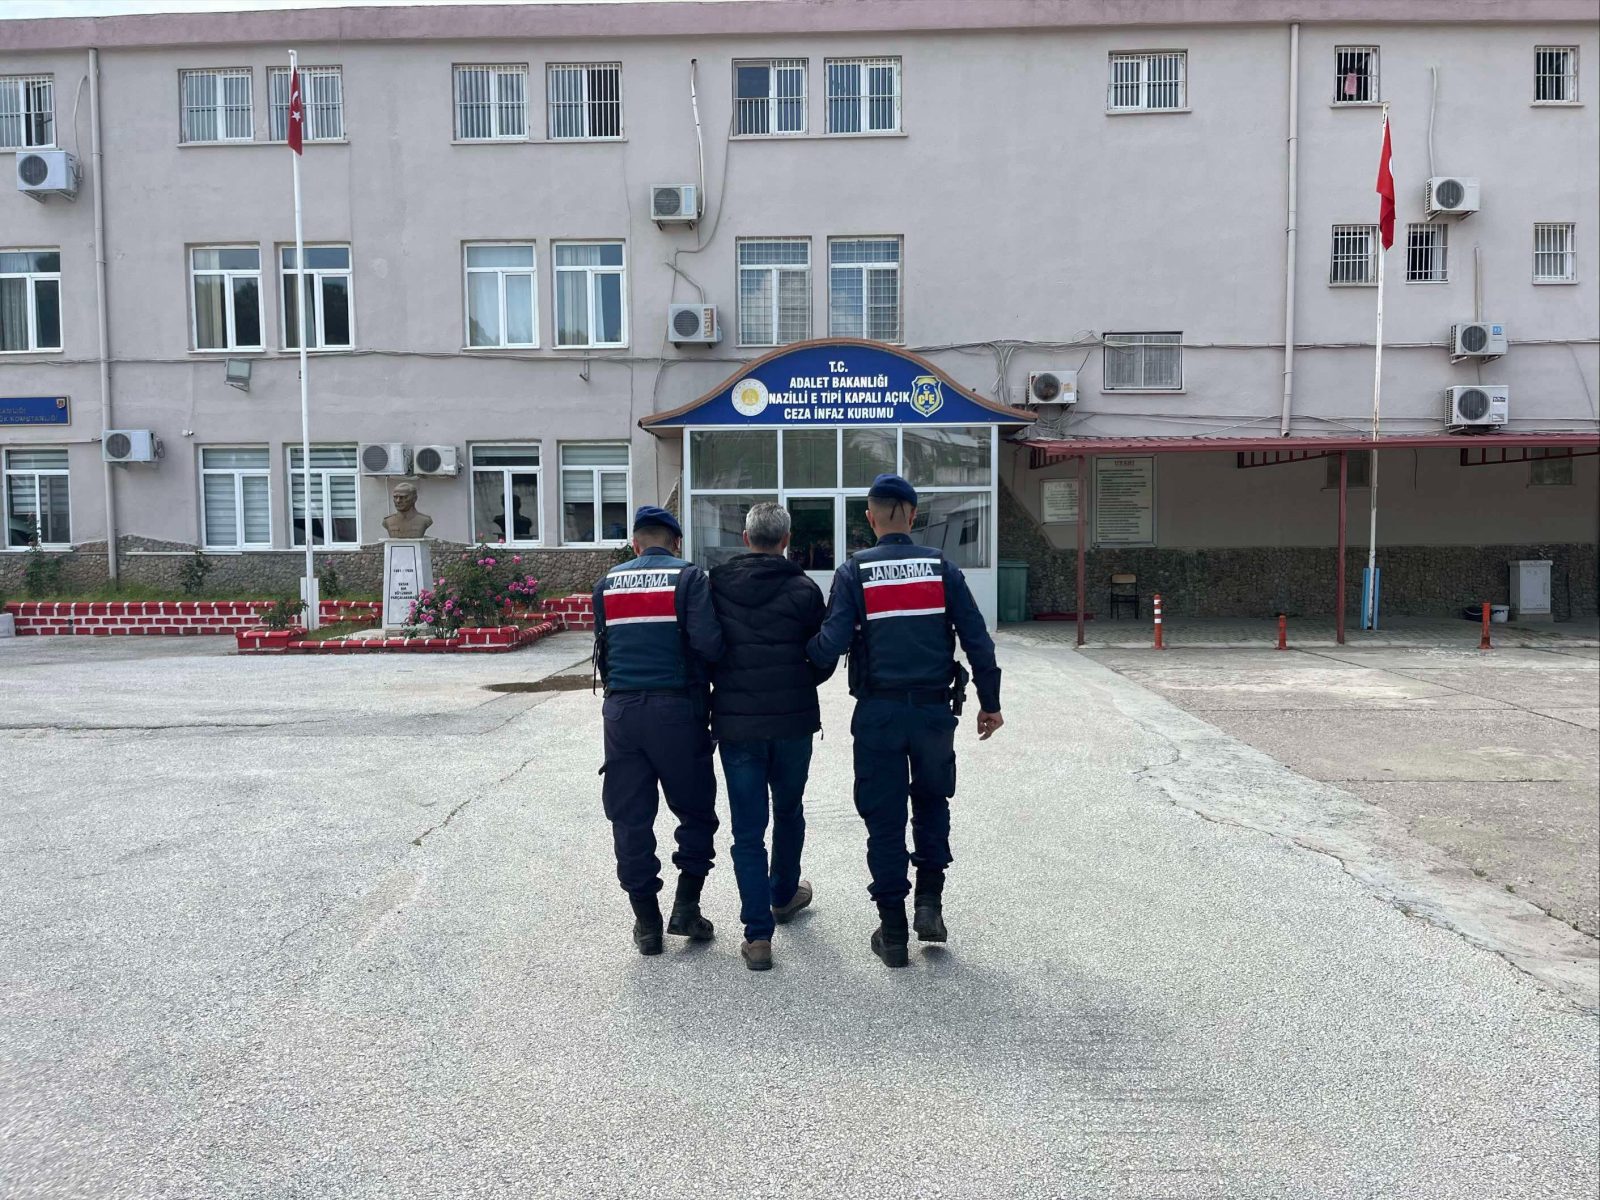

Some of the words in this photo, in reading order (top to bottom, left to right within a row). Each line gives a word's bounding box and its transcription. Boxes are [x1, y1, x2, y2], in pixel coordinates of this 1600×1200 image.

[829, 361, 848, 373] T.C.
[789, 377, 829, 389] ADALET
[832, 374, 888, 388] BAKANLIĞI
[769, 391, 808, 405] NAZİLLİ
[811, 393, 817, 404] E
[821, 390, 841, 404] TİPİ
[844, 392, 881, 404] KAPALI
[884, 391, 910, 406] AÇIK
[784, 408, 811, 420] CEZA
[814, 405, 844, 419] İNFAZ
[848, 407, 894, 419] KURUMU
[869, 563, 934, 580] JANDARMA
[610, 574, 669, 590] JANDARMA
